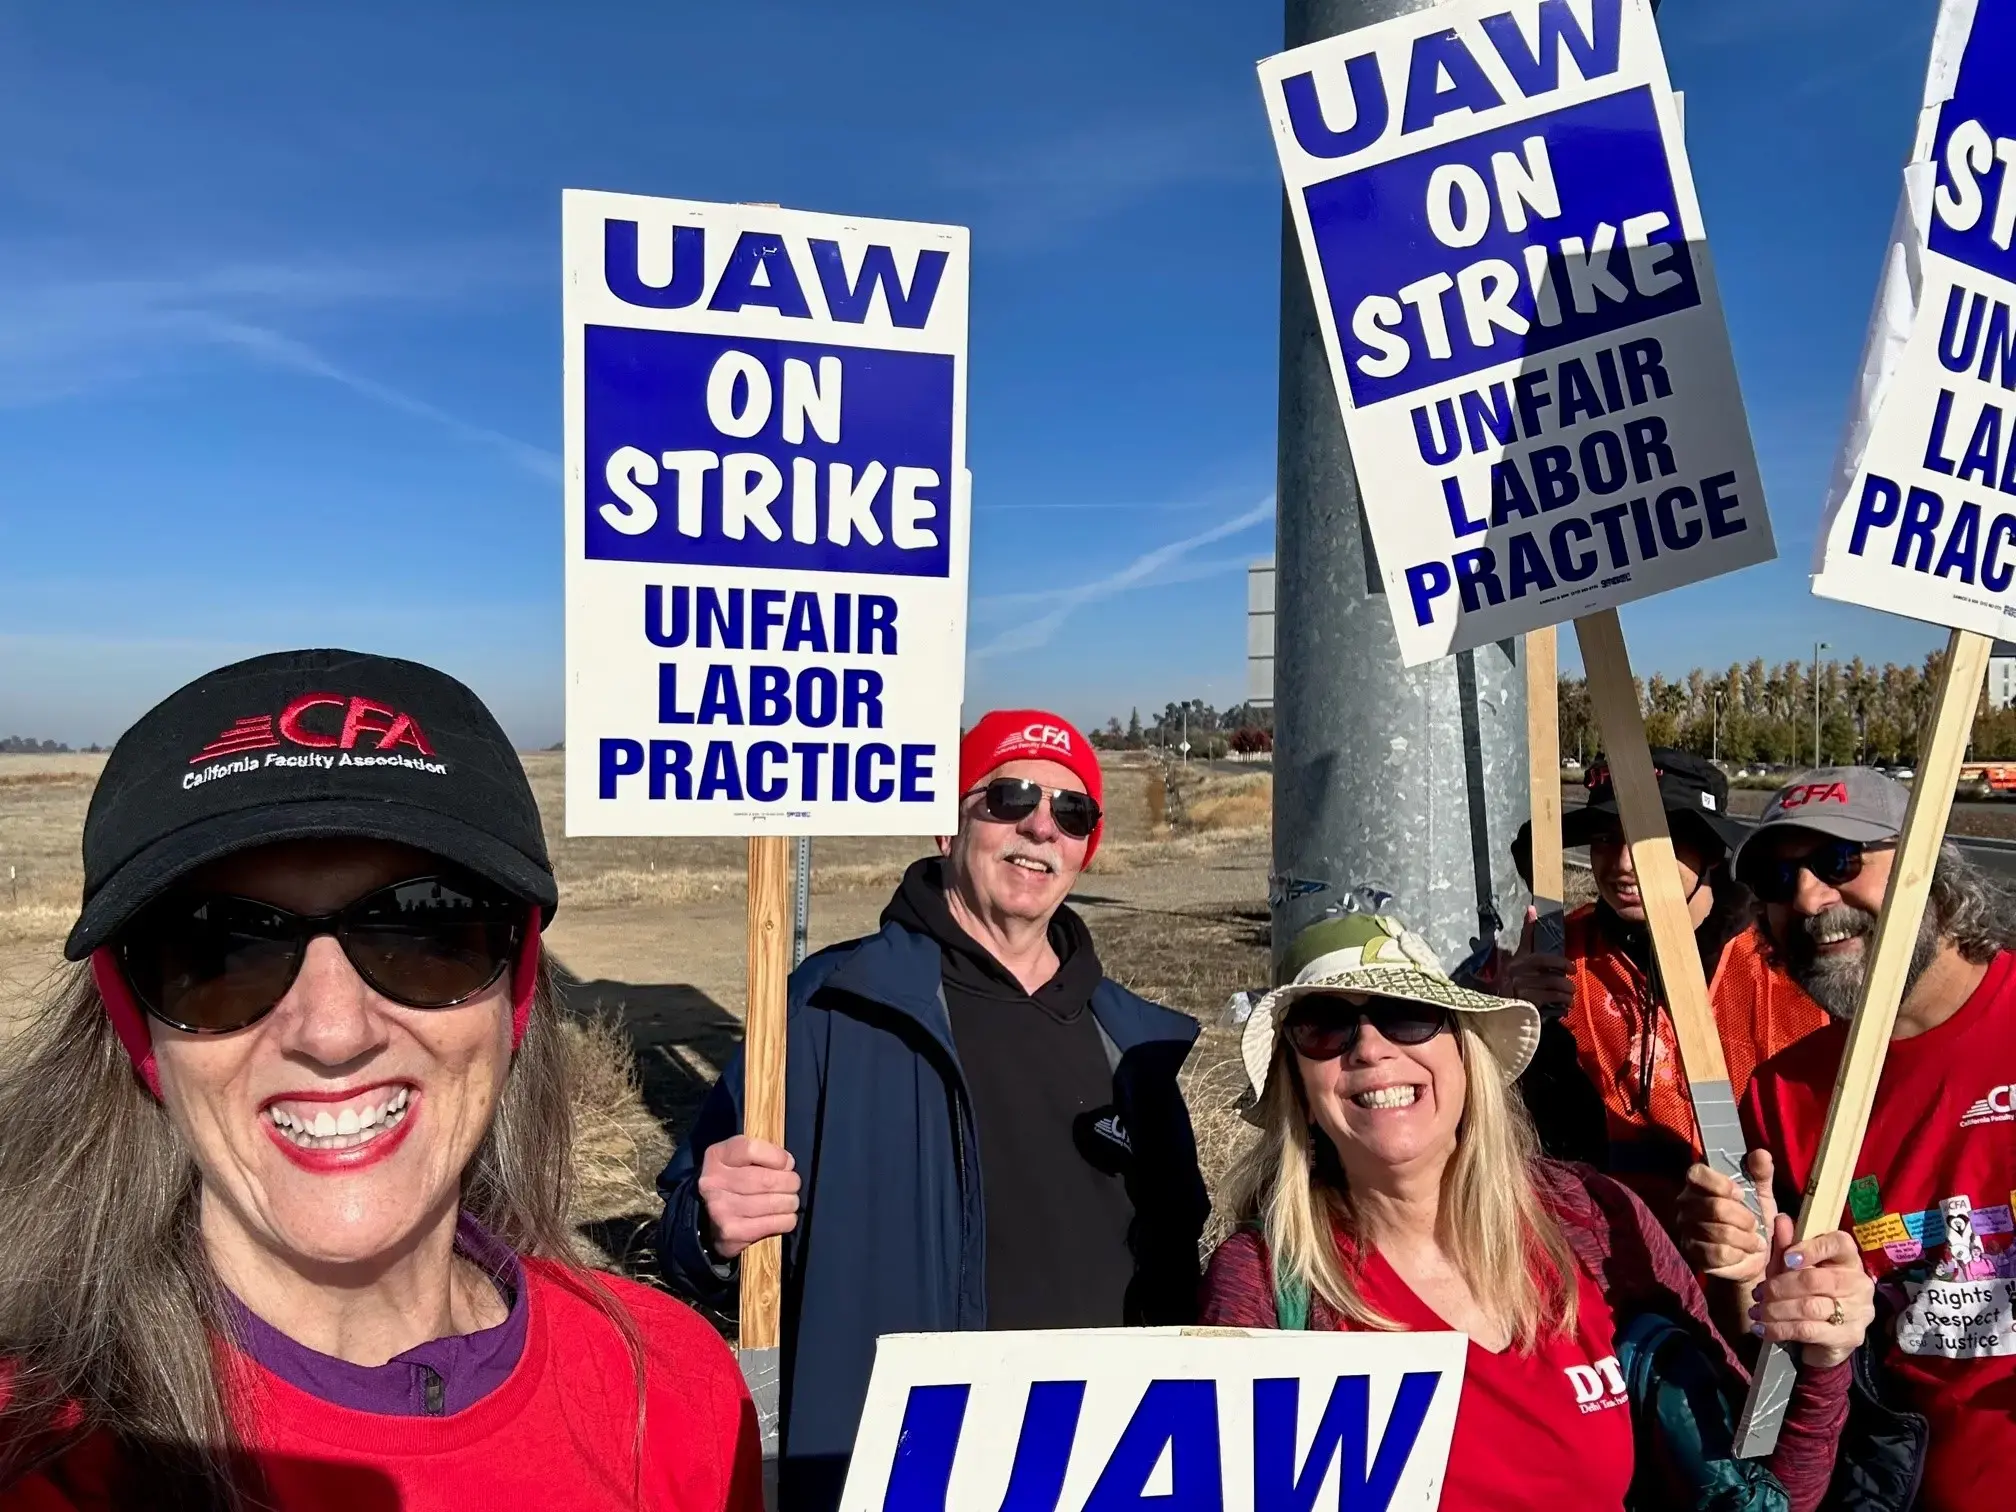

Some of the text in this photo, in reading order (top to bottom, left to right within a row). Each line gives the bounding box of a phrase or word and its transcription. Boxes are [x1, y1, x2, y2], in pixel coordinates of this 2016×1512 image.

[1281, 0, 1621, 158] UAW
[1427, 136, 1561, 248] ON
[605, 218, 949, 329] UAW
[1352, 212, 1682, 378] STRIKE
[706, 350, 842, 445] ON
[1411, 337, 1673, 466] UNFAIR
[600, 446, 940, 549] STRIKE
[1442, 416, 1677, 538] LABOR
[1405, 471, 1747, 627] PRACTICE
[645, 585, 898, 655] UNFAIR
[280, 692, 436, 756] CFA
[659, 663, 884, 728] LABOR
[1023, 724, 1070, 750] CFA
[182, 753, 447, 790] California Faculty Association
[600, 738, 936, 802] PRACTICE
[1780, 782, 1848, 808] CFA
[1960, 1117, 1990, 1127] California
[1948, 1200, 1967, 1210] CFA
[1924, 1308, 2000, 1332] Respect
[1928, 1287, 1992, 1309] Rights
[1910, 1339, 1927, 1347] CSU
[1935, 1332, 1999, 1350] Justice
[1579, 1402, 1601, 1414] Delhi
[883, 1371, 1442, 1512] UAW
